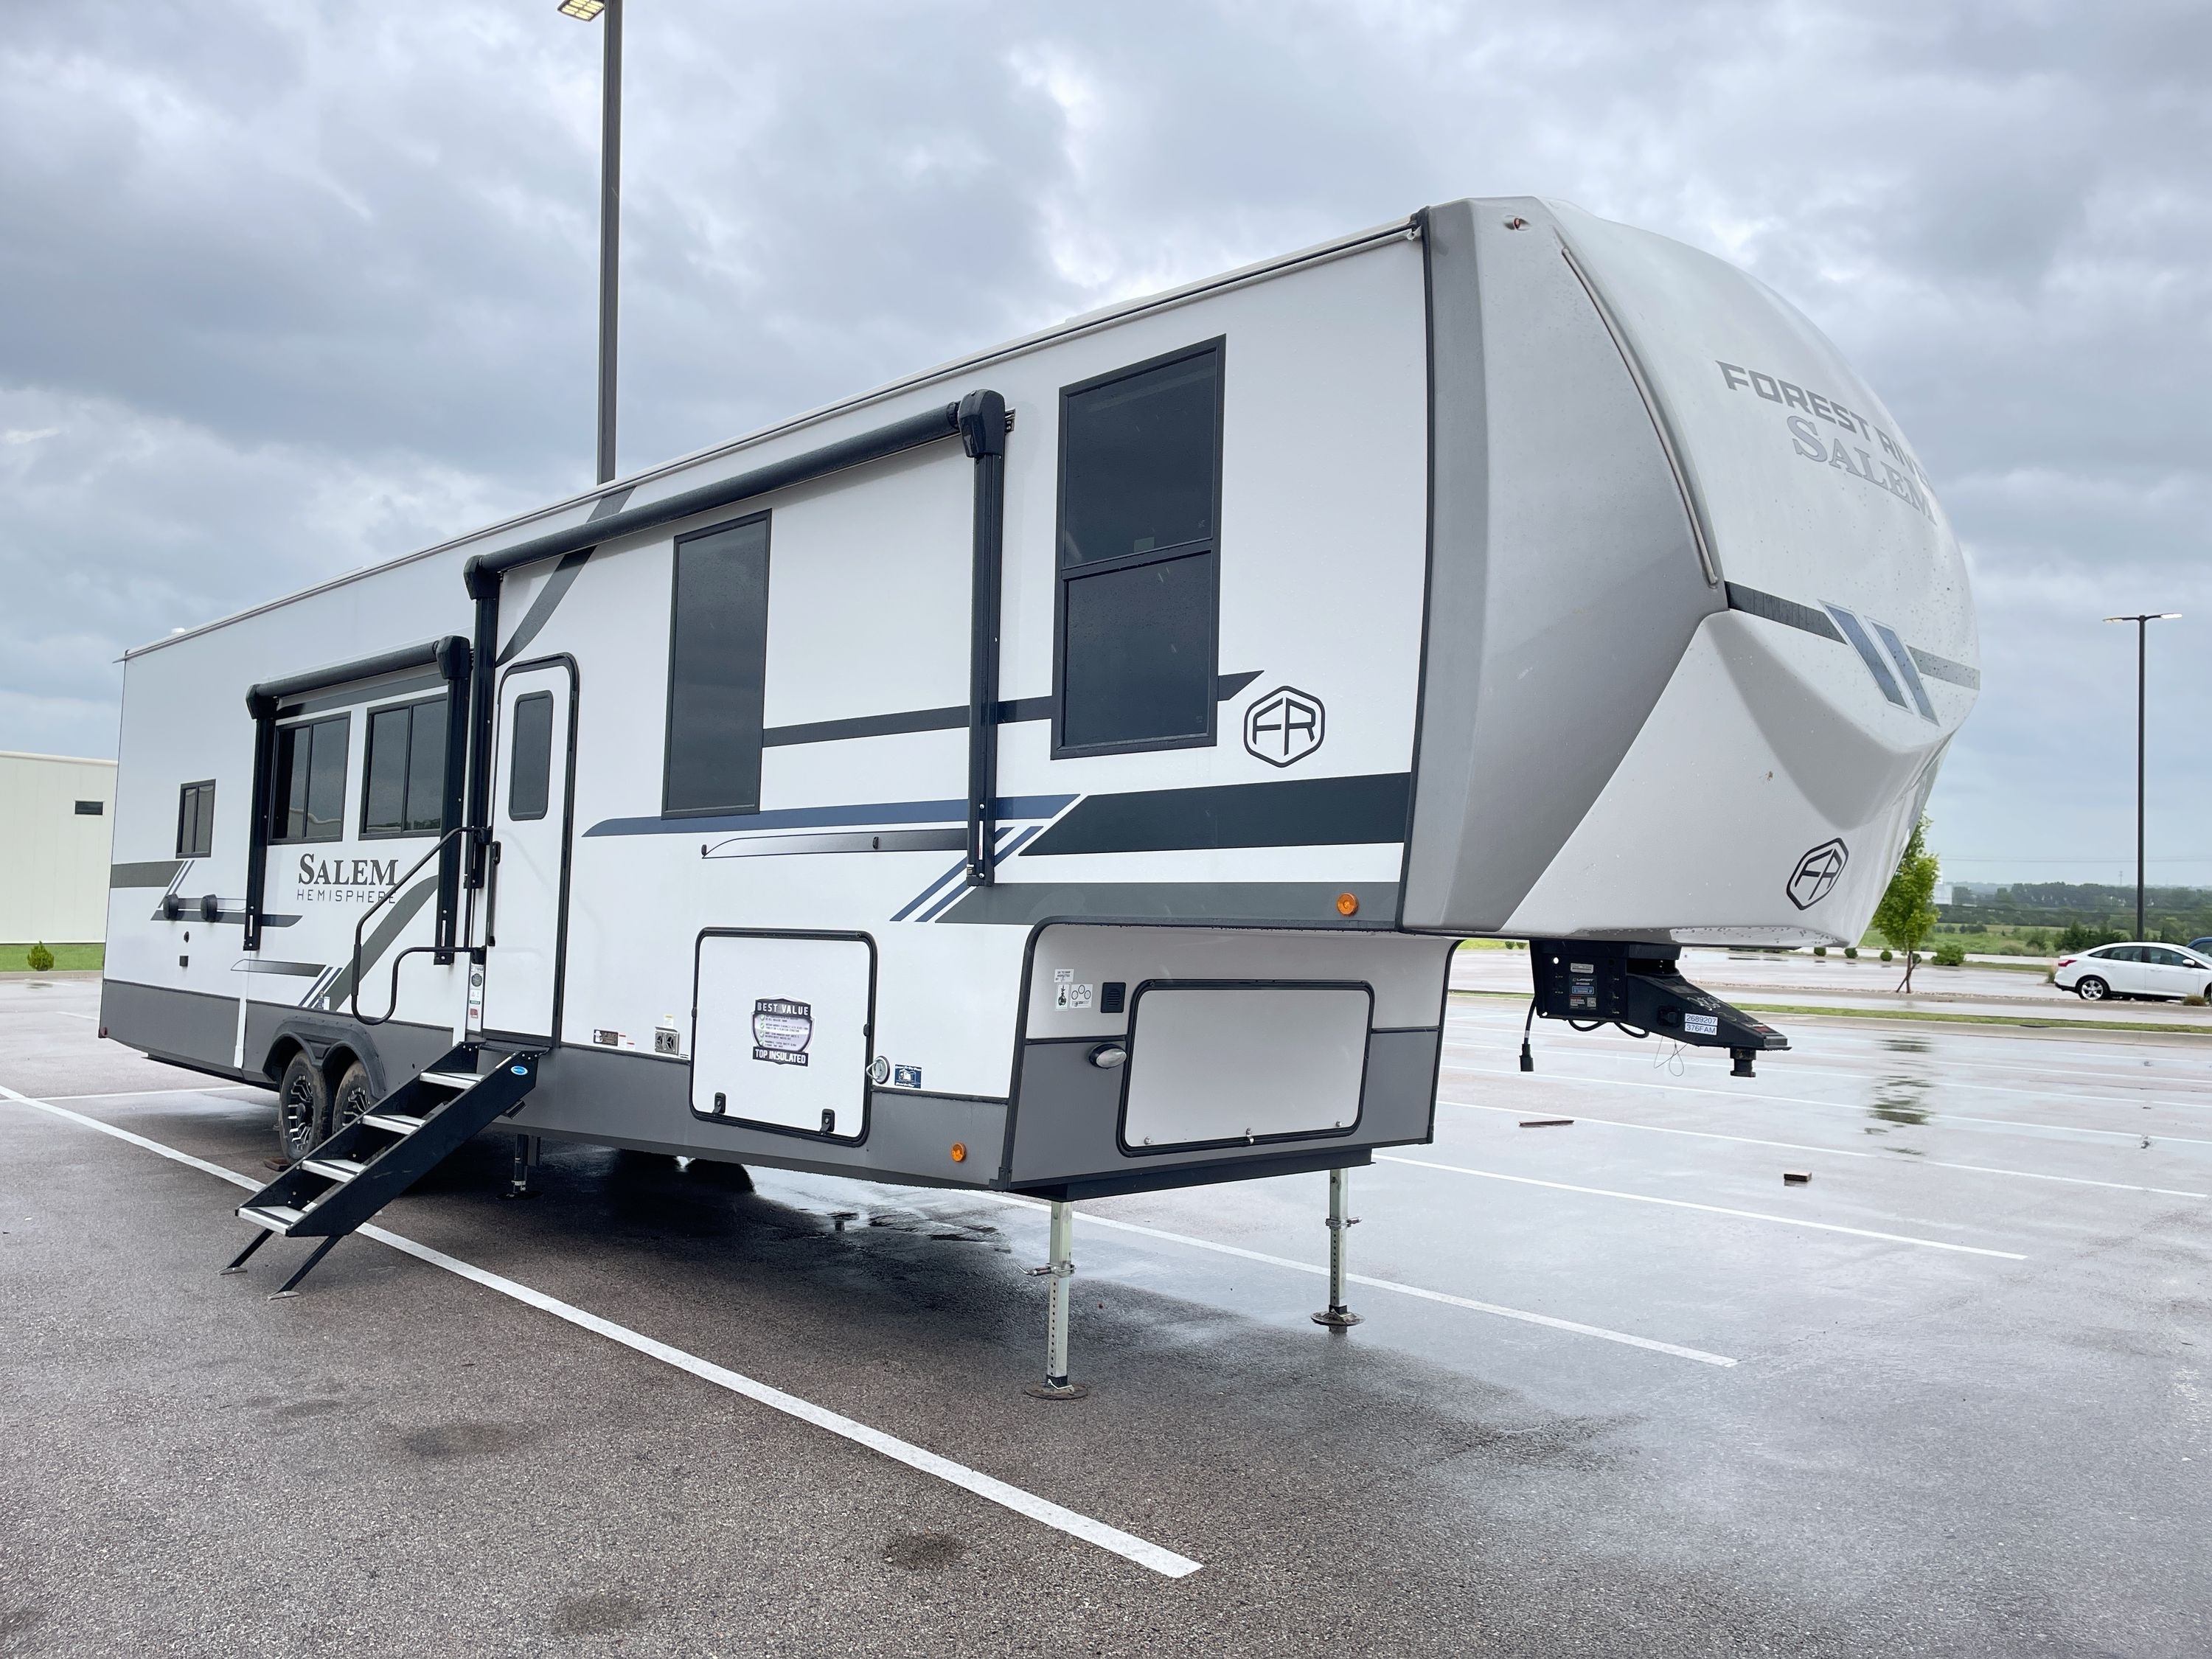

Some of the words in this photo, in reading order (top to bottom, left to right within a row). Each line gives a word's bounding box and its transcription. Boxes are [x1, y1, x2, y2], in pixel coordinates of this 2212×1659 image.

[1715, 360, 1871, 442] FOREST
[298, 853, 399, 886] SALEM
[757, 1002, 778, 1012] BEST
[782, 1004, 808, 1015] VALUE
[1686, 1015, 1717, 1025] 2689207
[1686, 1023, 1716, 1034] 376FAM
[755, 1049, 768, 1058] TOP
[769, 1050, 806, 1064] INSULATED
